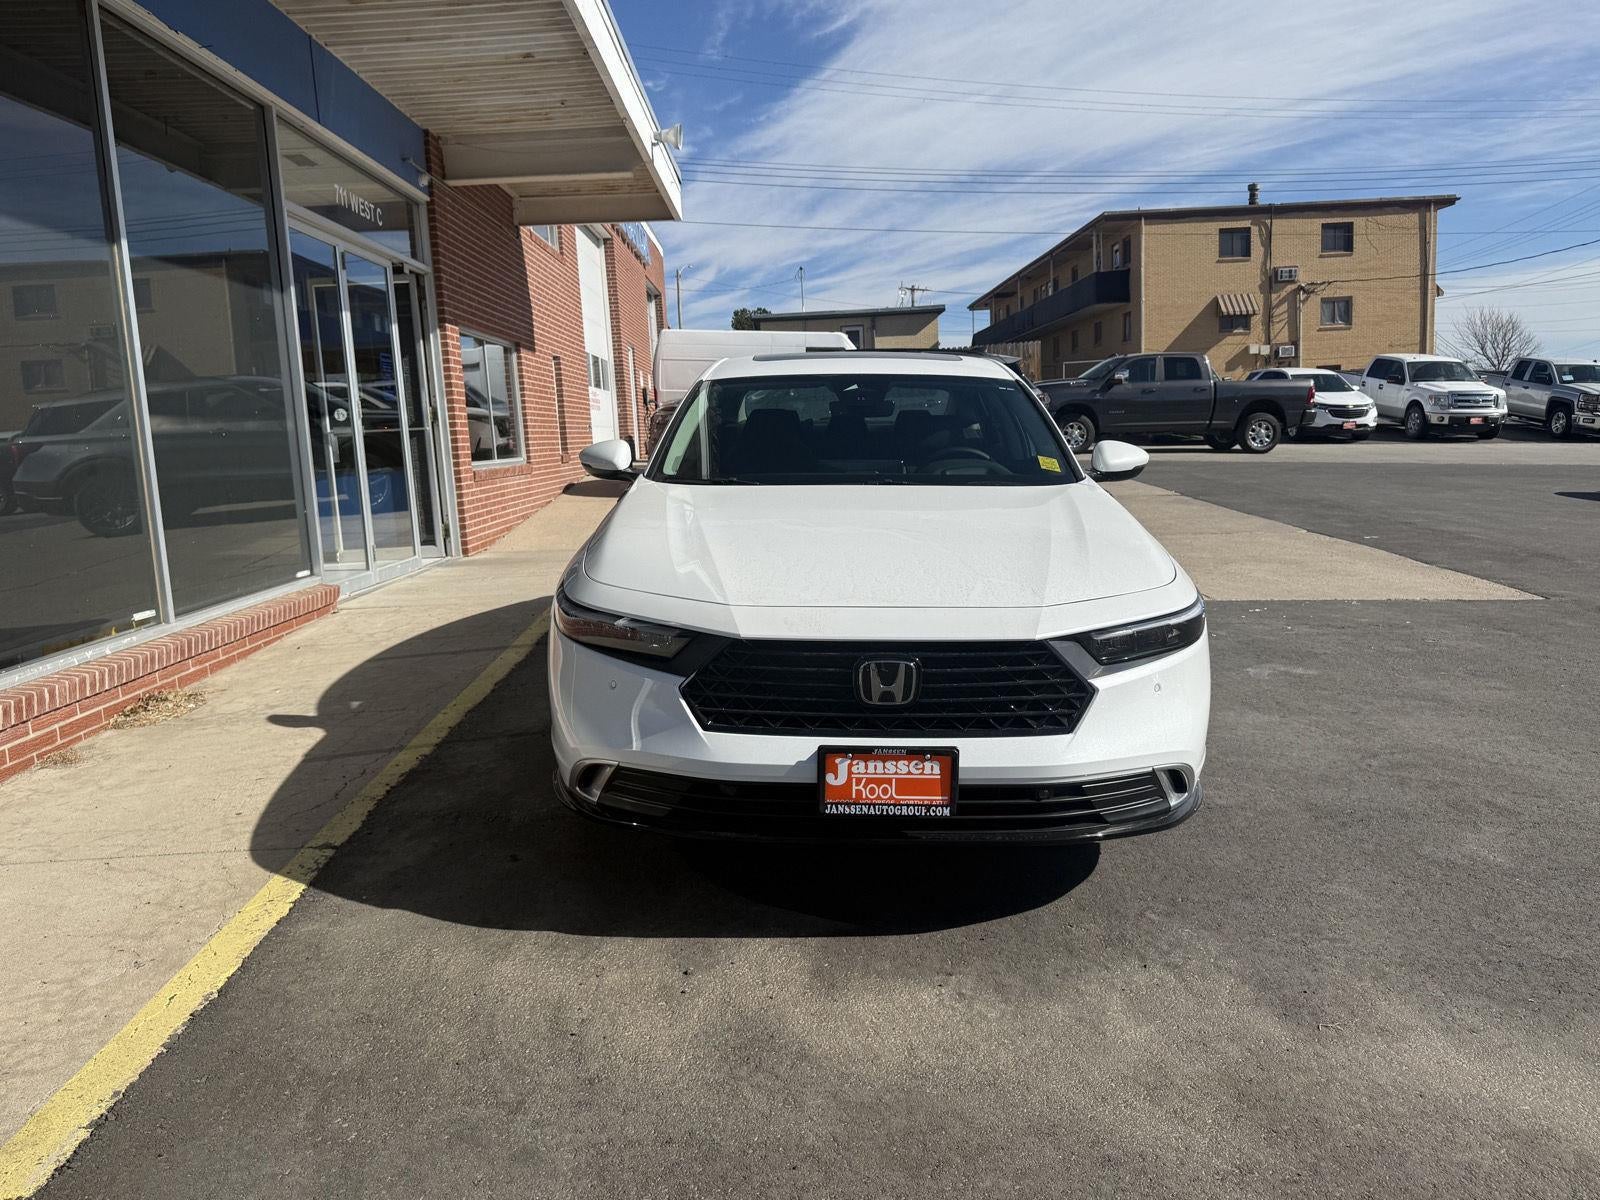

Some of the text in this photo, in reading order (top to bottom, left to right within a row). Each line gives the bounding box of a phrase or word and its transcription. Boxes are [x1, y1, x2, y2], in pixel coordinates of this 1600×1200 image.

[334, 184, 383, 227] 711 WEST C
[826, 757, 941, 786] Janssen
